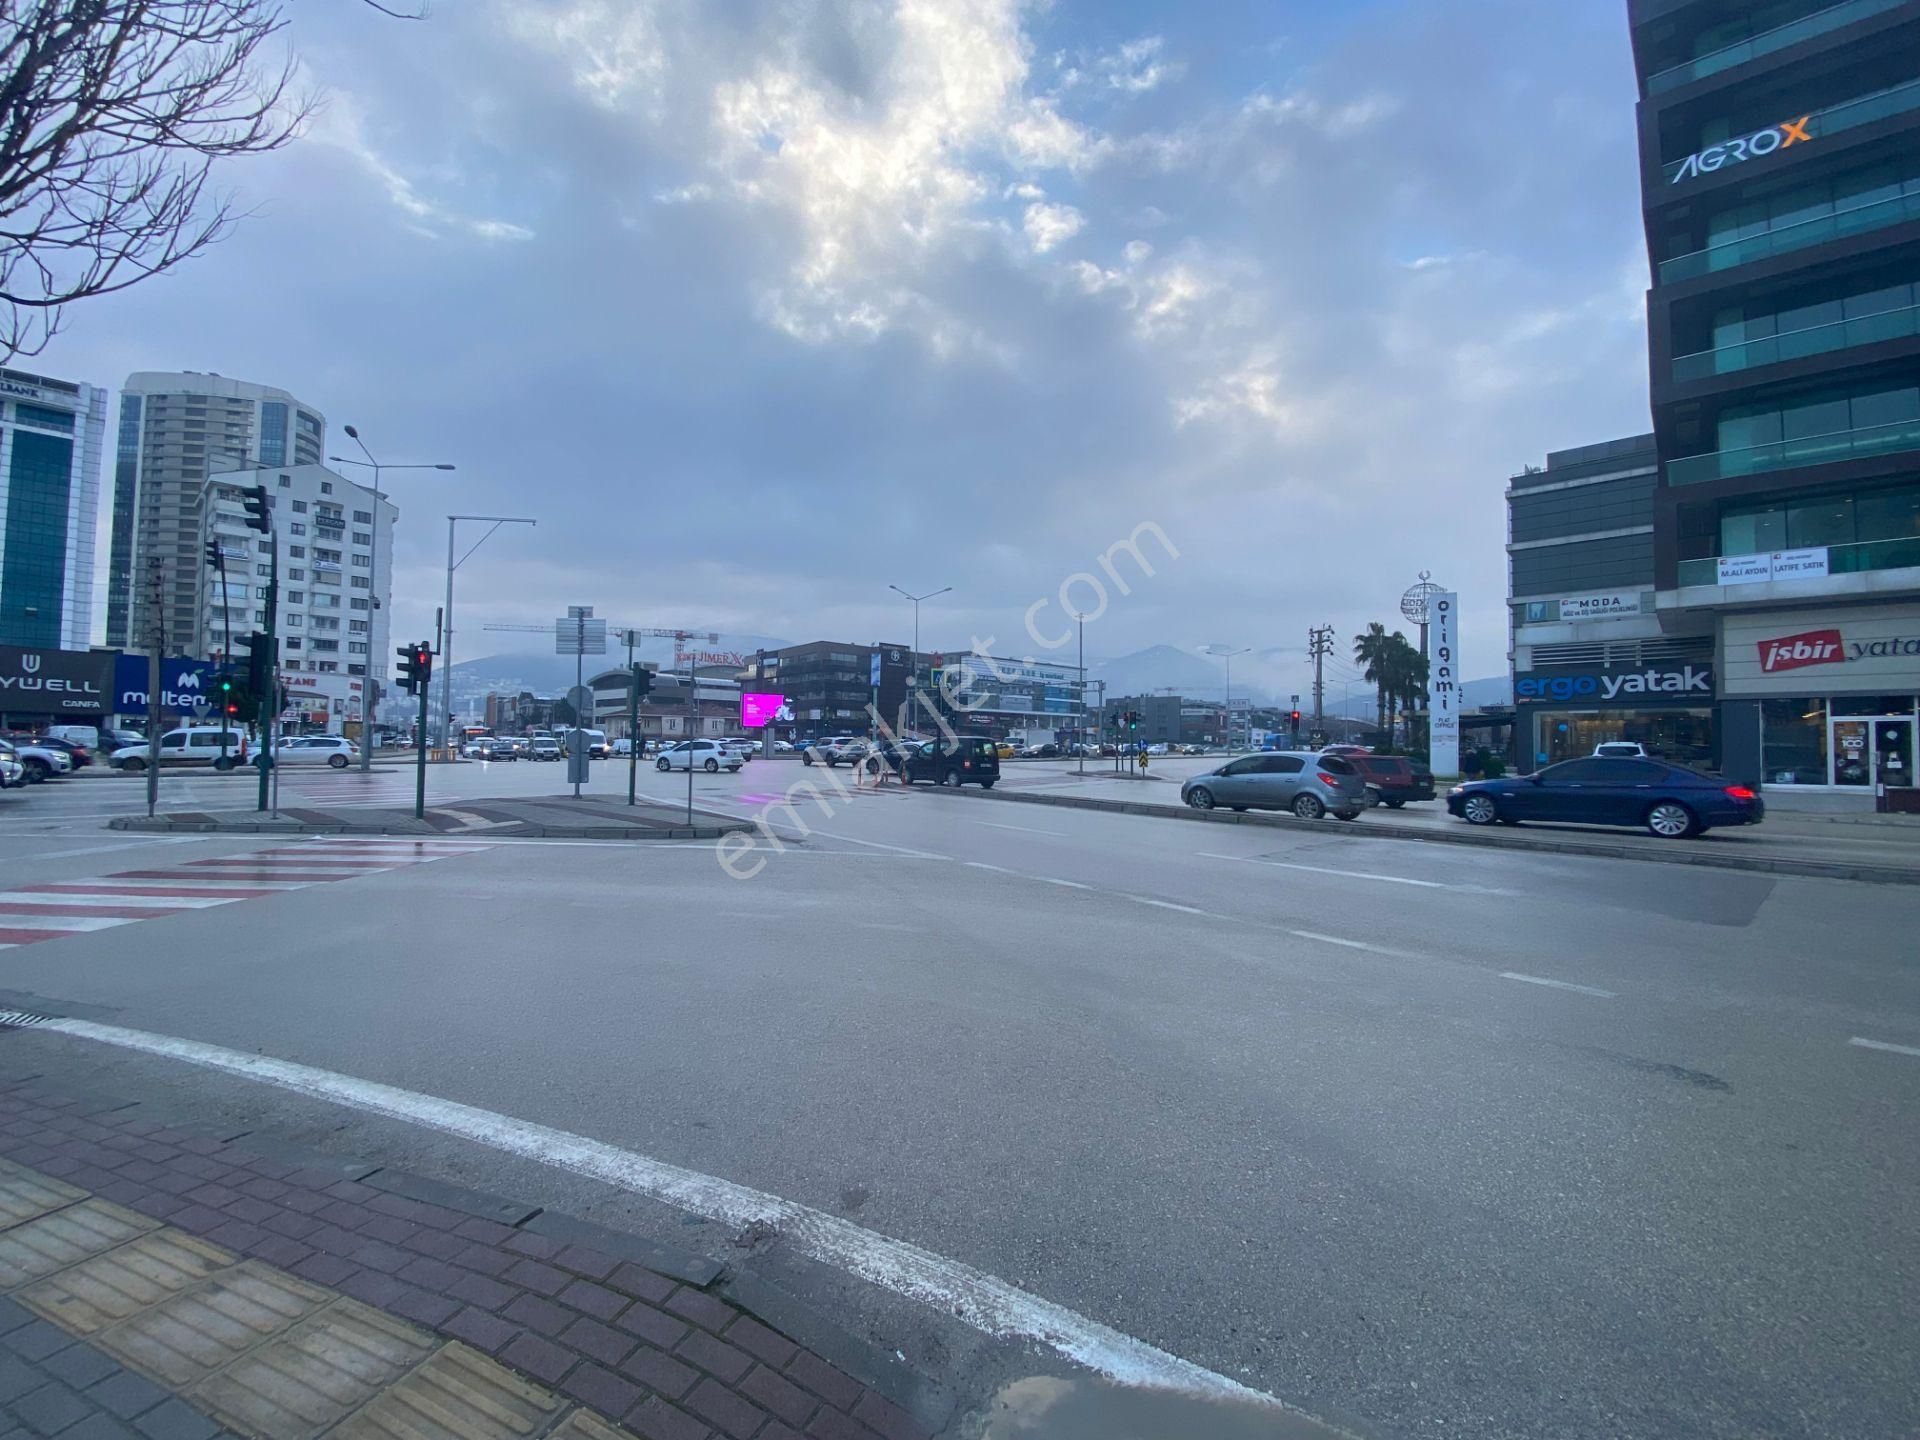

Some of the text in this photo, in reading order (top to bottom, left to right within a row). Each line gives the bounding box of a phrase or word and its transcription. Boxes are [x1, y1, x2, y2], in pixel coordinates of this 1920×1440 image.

[1672, 116, 1812, 184] AGROX
[1579, 597, 1621, 608] MODA
[1517, 666, 1711, 701] ergo yatak
[62, 700, 100, 708] CANFA
